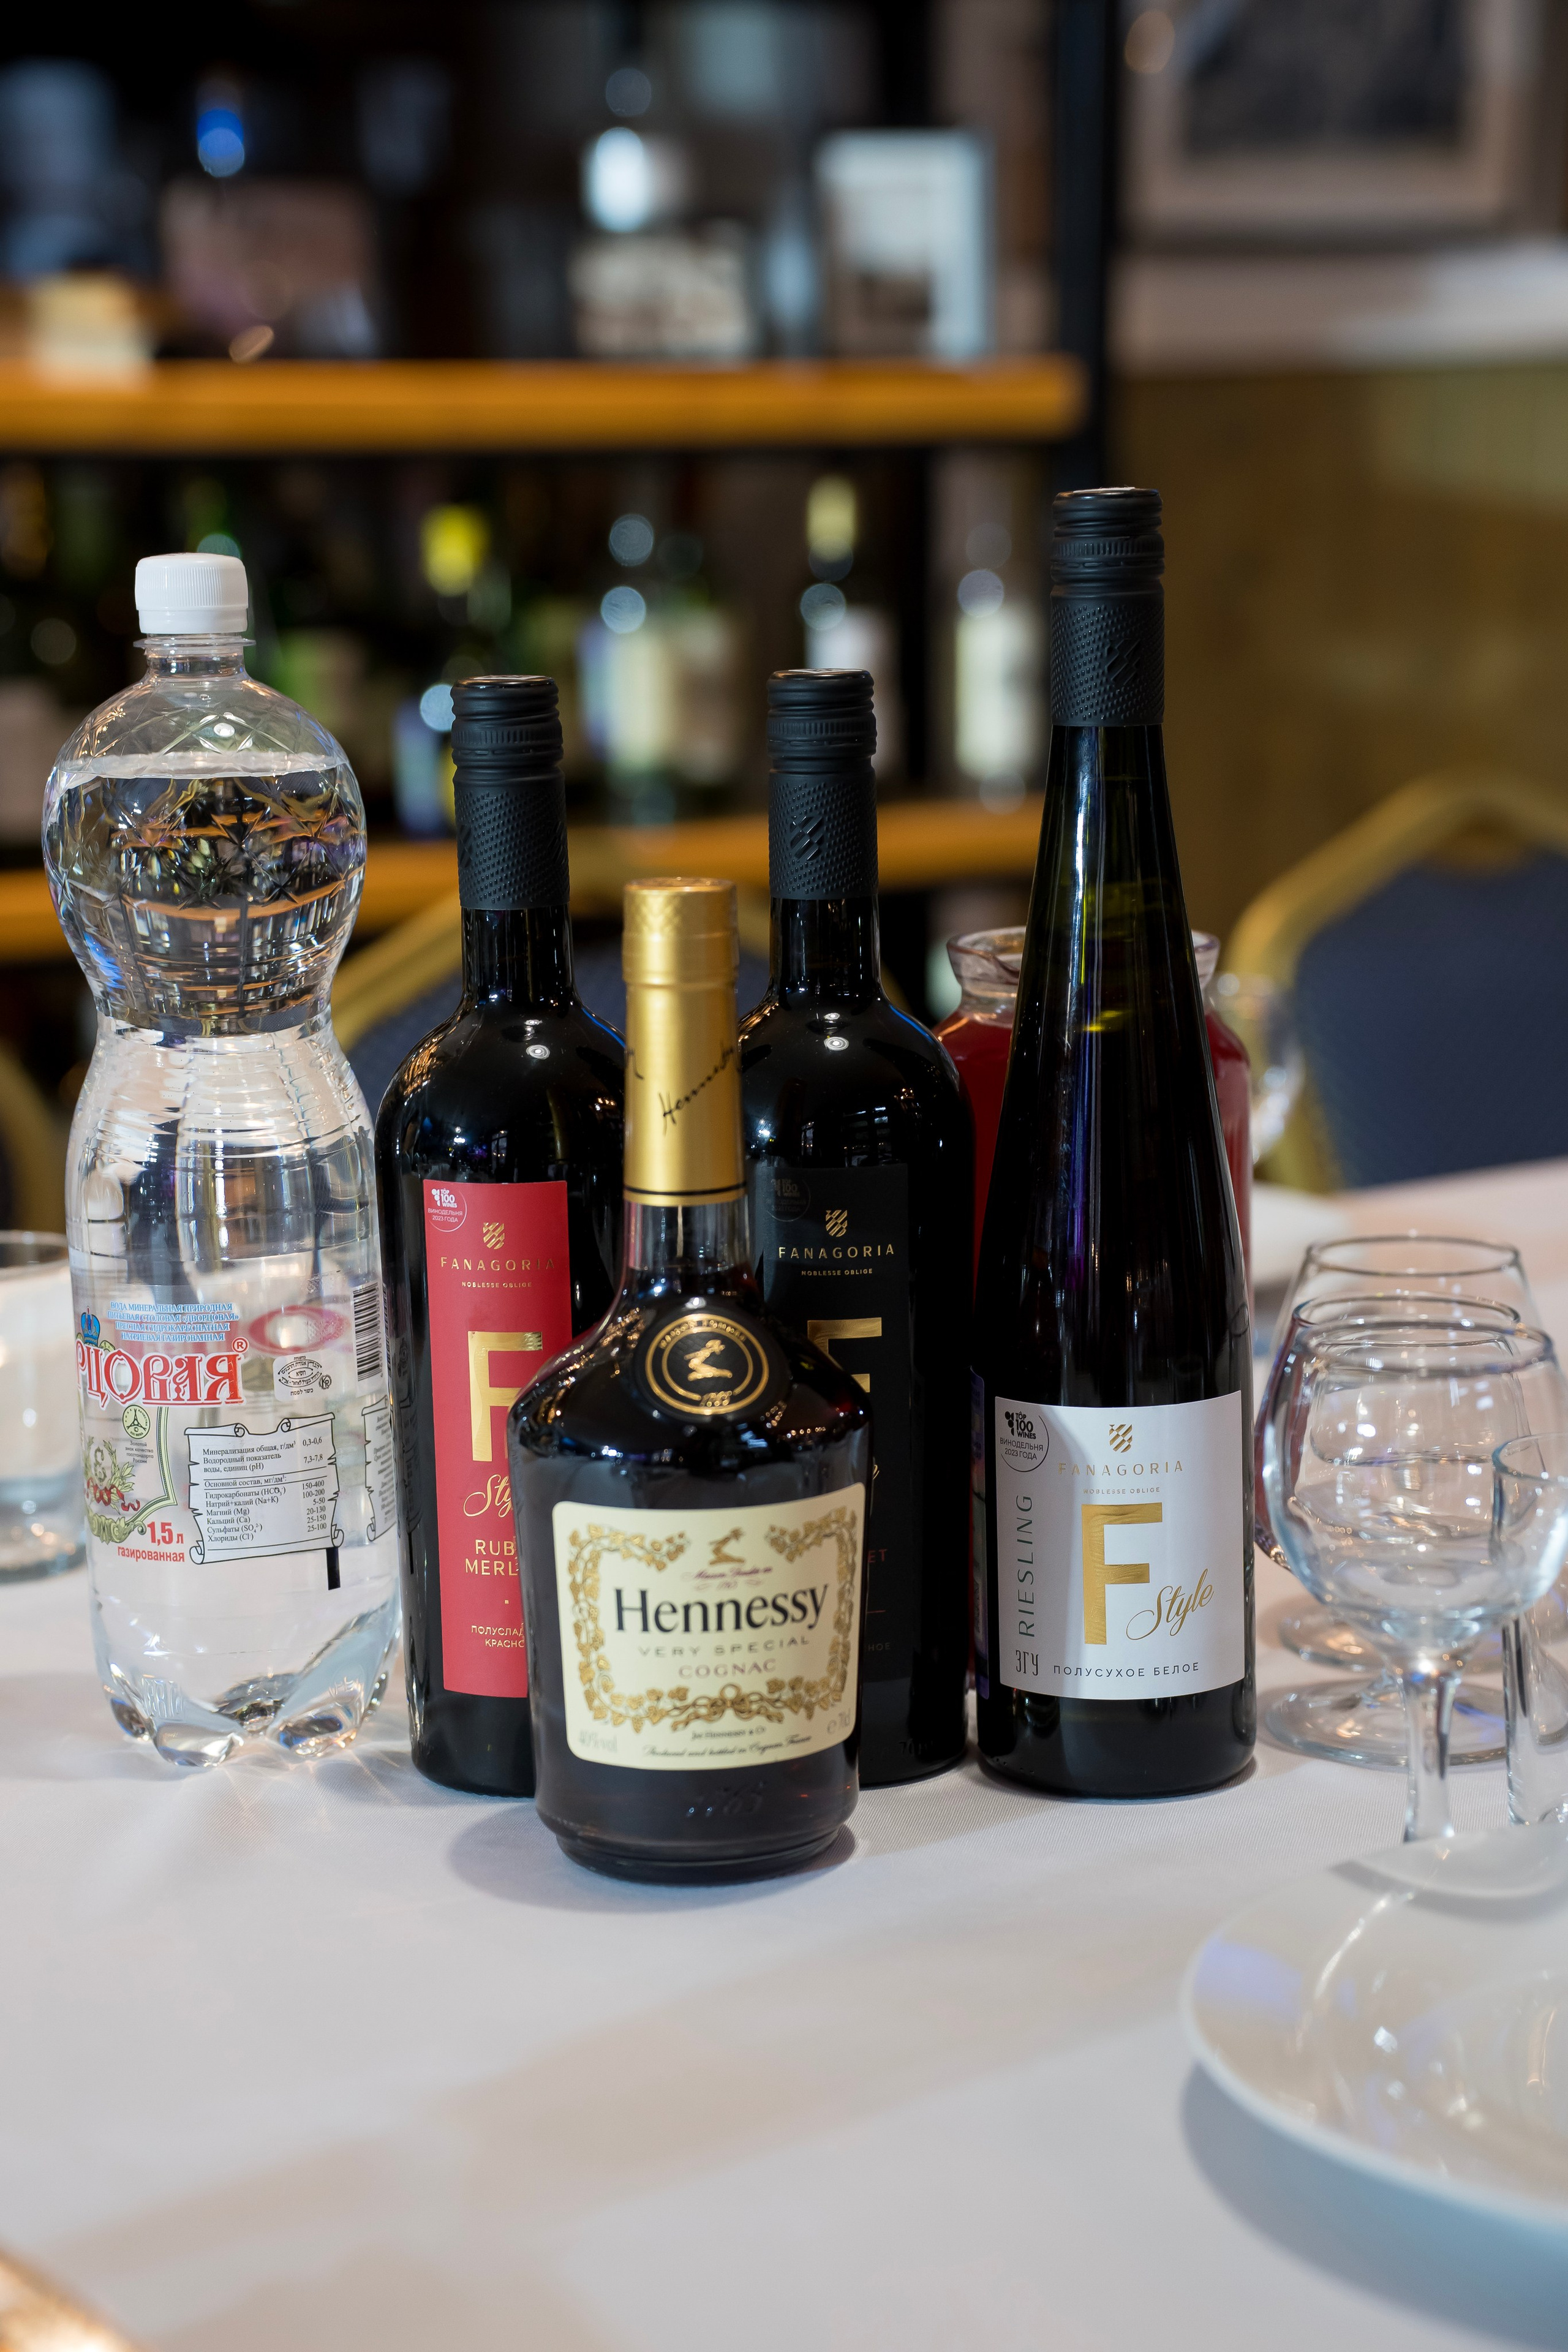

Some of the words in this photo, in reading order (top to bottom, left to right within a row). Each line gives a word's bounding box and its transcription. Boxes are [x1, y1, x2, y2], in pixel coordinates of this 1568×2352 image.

[441, 1194, 455, 1203] 100
[778, 1244, 894, 1259] FANAGORIA
[440, 1256, 554, 1271] FANAGORIA
[110, 1302, 127, 1310] ВОДА
[129, 1303, 183, 1313] МИНЕРАЛЬНАЯ
[184, 1303, 233, 1312] ПРИРОДНАЯ
[107, 1311, 139, 1321] ПИТЬЕВАЯ
[141, 1314, 181, 1322] СТОЛОВАЯ
[182, 1313, 239, 1323] «ДВОРЦОВАЯ»
[116, 1322, 145, 1331] ПРЕСНАЯ
[146, 1323, 229, 1333] ГИДРОКАРБОНАТНАЯ
[121, 1332, 160, 1341] НАТРИЕВАЯ
[162, 1333, 225, 1342] ГАЗИРОВАННАЯ
[76, 1340, 244, 1408] РЦОВАЯ
[468, 1331, 543, 1461] F
[1016, 1419, 1033, 1433] 100
[1017, 1431, 1036, 1439] WINES
[203, 1447, 254, 1456] Минерализация
[303, 1437, 322, 1446] 0,3-0,6
[1000, 1437, 1044, 1451] ВИНОДЕЛЬНЯ
[203, 1455, 244, 1464] Водородный
[246, 1453, 281, 1462] показатель
[249, 1462, 264, 1472] (pH)
[304, 1453, 323, 1463] 7,3-7,8
[1005, 1448, 1018, 1457] 2023
[1019, 1451, 1037, 1460] ГОДА
[1058, 1460, 1183, 1476] FANAGORIA
[205, 1490, 259, 1499] Гидрокарбонаты
[303, 1480, 324, 1490] 150-400
[206, 1498, 254, 1508] Натрий+калий
[255, 1496, 279, 1506] (Na+K)
[303, 1488, 325, 1499] 100-200
[463, 1474, 512, 1517] Sty
[233, 1507, 250, 1517] (Mg)
[236, 1516, 251, 1525] (Ca)
[306, 1506, 326, 1515] 20-130
[207, 1525, 239, 1534] Сульфаты
[307, 1514, 326, 1523] 25-150
[148, 1521, 173, 1545] 1,5
[176, 1533, 184, 1544] л
[208, 1534, 238, 1543] Хлориды
[307, 1523, 327, 1532] 25-100
[118, 1546, 185, 1562] газированная
[475, 1539, 514, 1556] RUB
[465, 1558, 518, 1576] MERL
[1016, 1494, 1035, 1637] RIESLING
[1081, 1502, 1163, 1645] F
[614, 1583, 829, 1634] Hennessy
[1126, 1568, 1215, 1640] Style
[471, 1625, 523, 1637] ПОЛУСЛАД
[485, 1638, 524, 1648] КРАСНО
[638, 1644, 702, 1657] VERY
[714, 1635, 810, 1656] SPECIAL
[679, 1658, 776, 1679] COGNAC
[1016, 1649, 1039, 1676] ЗГУ
[1054, 1665, 1145, 1677] ПОЛУСУХОЕ
[1154, 1662, 1199, 1676] БЕЛОЕ
